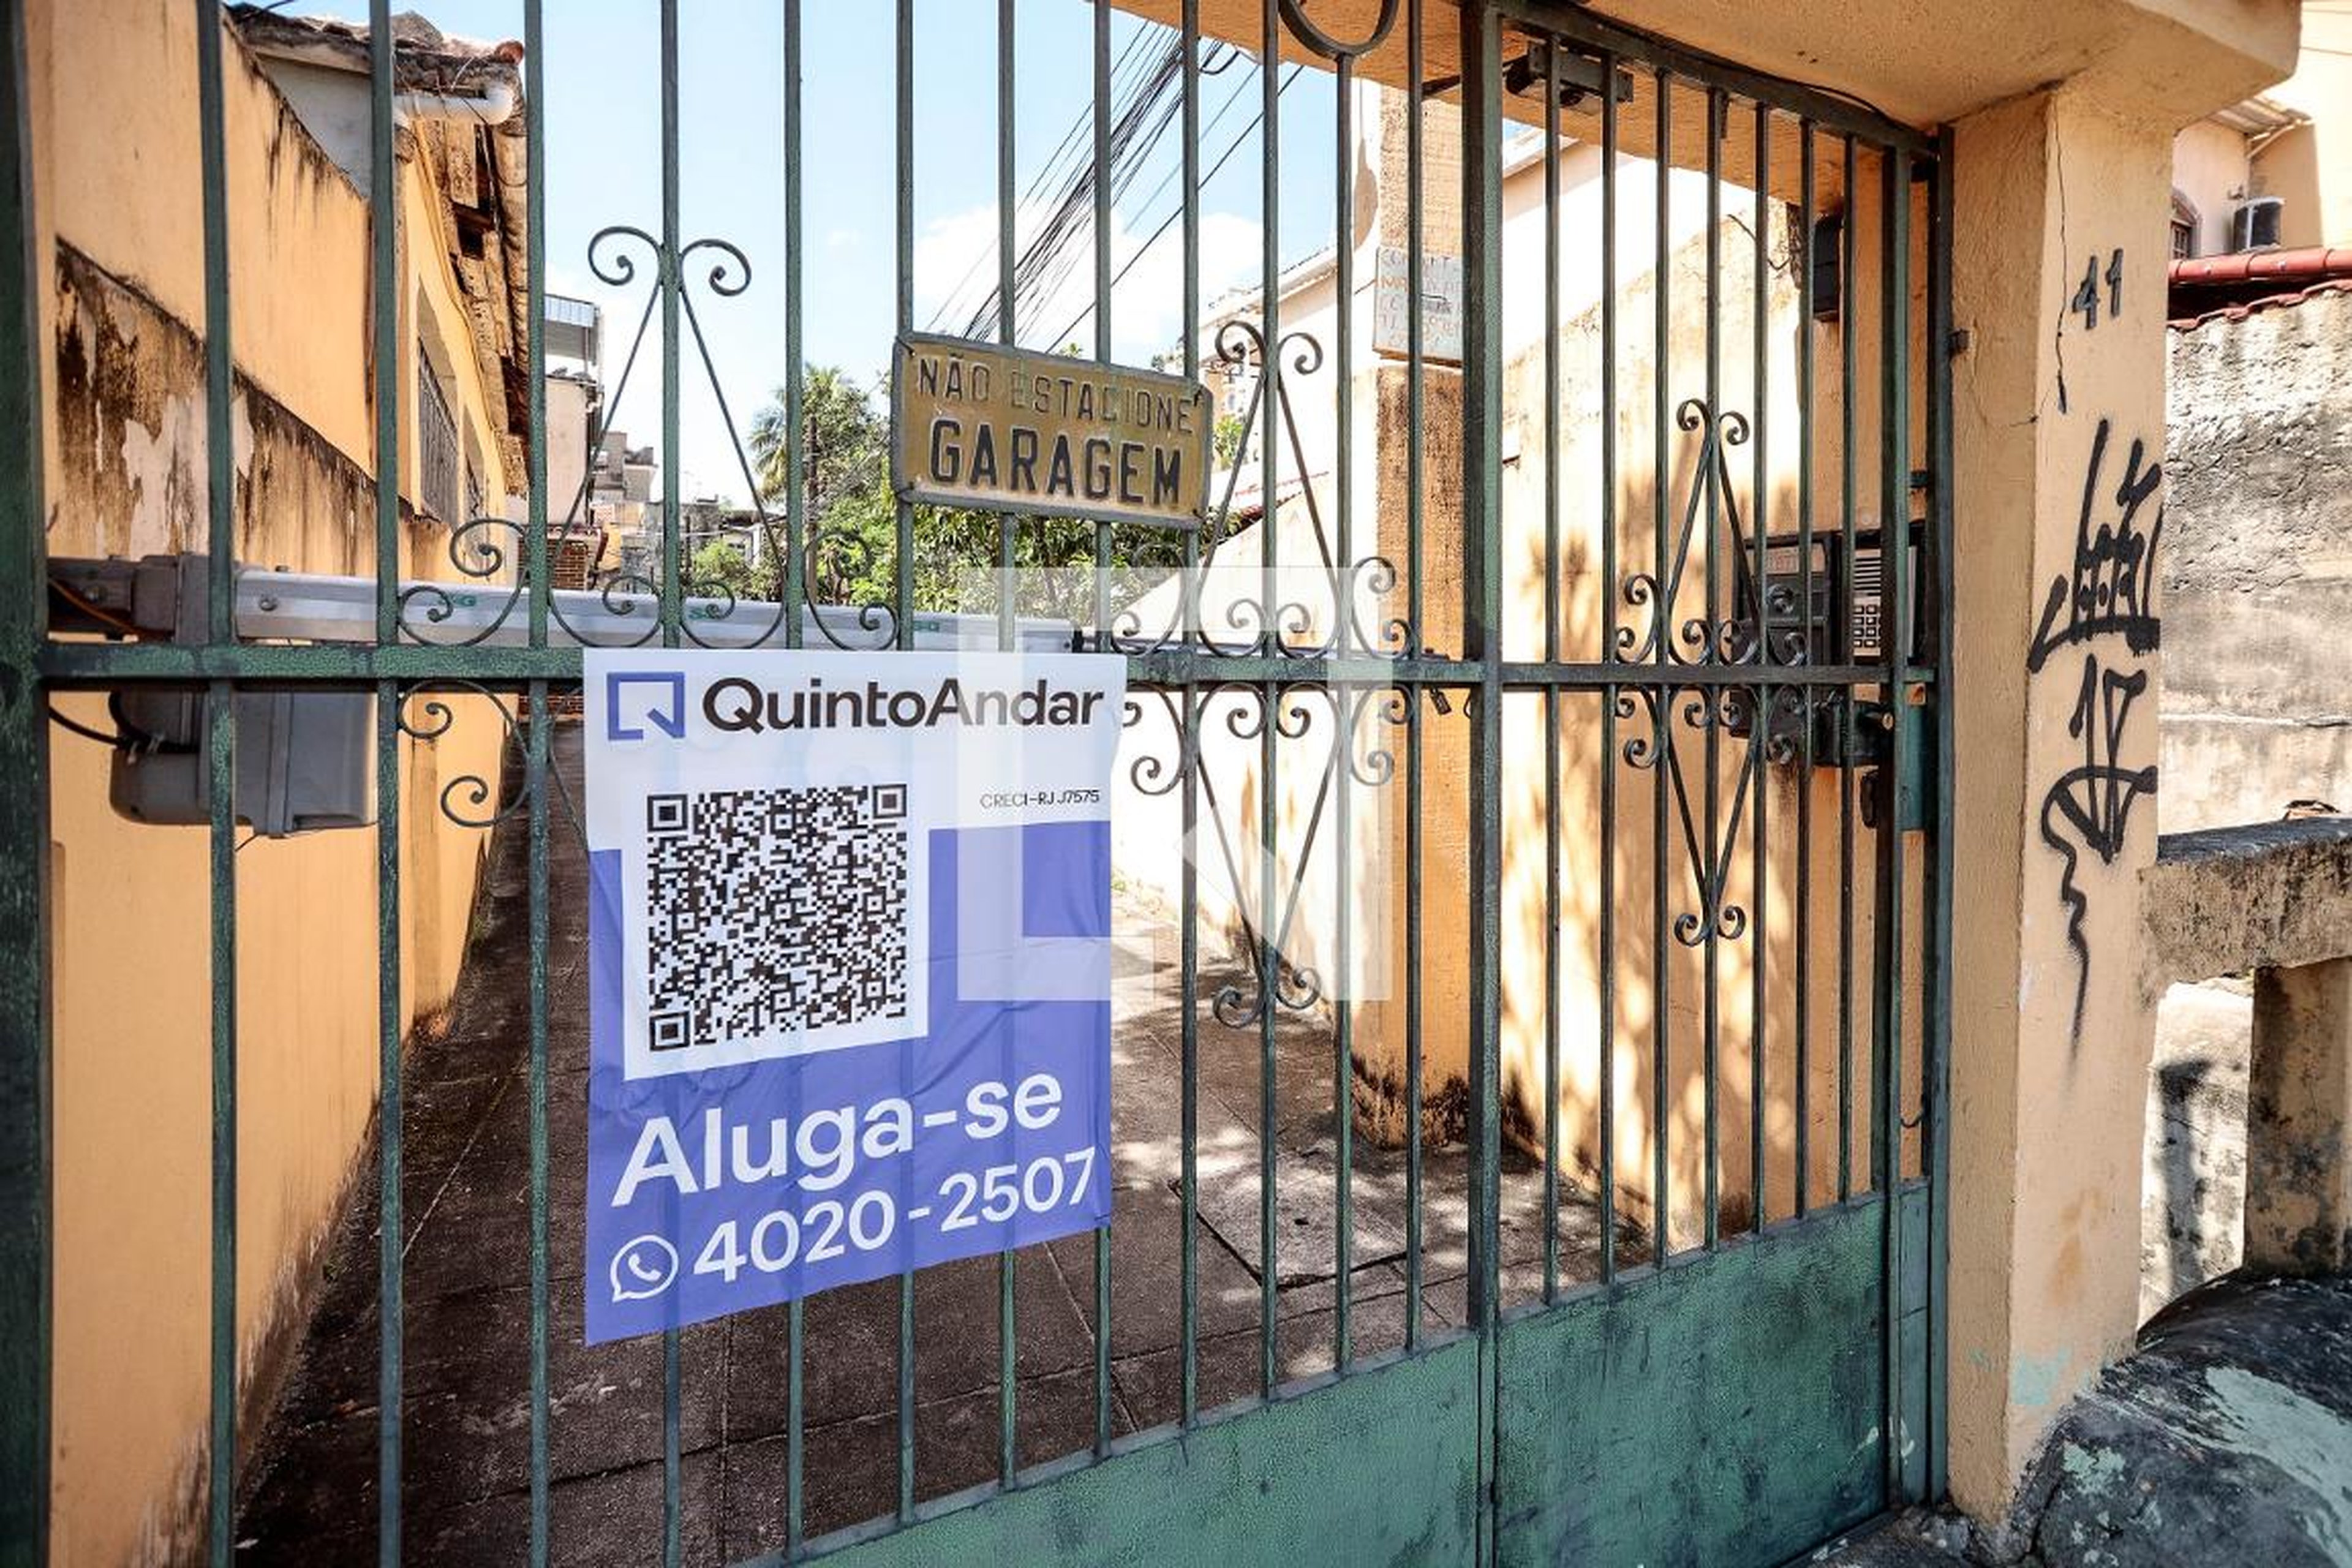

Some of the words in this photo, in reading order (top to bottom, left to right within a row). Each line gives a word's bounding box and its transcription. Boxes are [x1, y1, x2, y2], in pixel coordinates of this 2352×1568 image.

[918, 353, 990, 402] NÃO
[1011, 371, 1193, 434] ESTACIONE
[930, 419, 1181, 504] GARAGEM
[703, 677, 1104, 734] QuintoAndar
[980, 791, 1055, 809] CRECI-RJ
[611, 1072, 1063, 1207] Aluga-se
[693, 1146, 1096, 1281] 4020-2507
